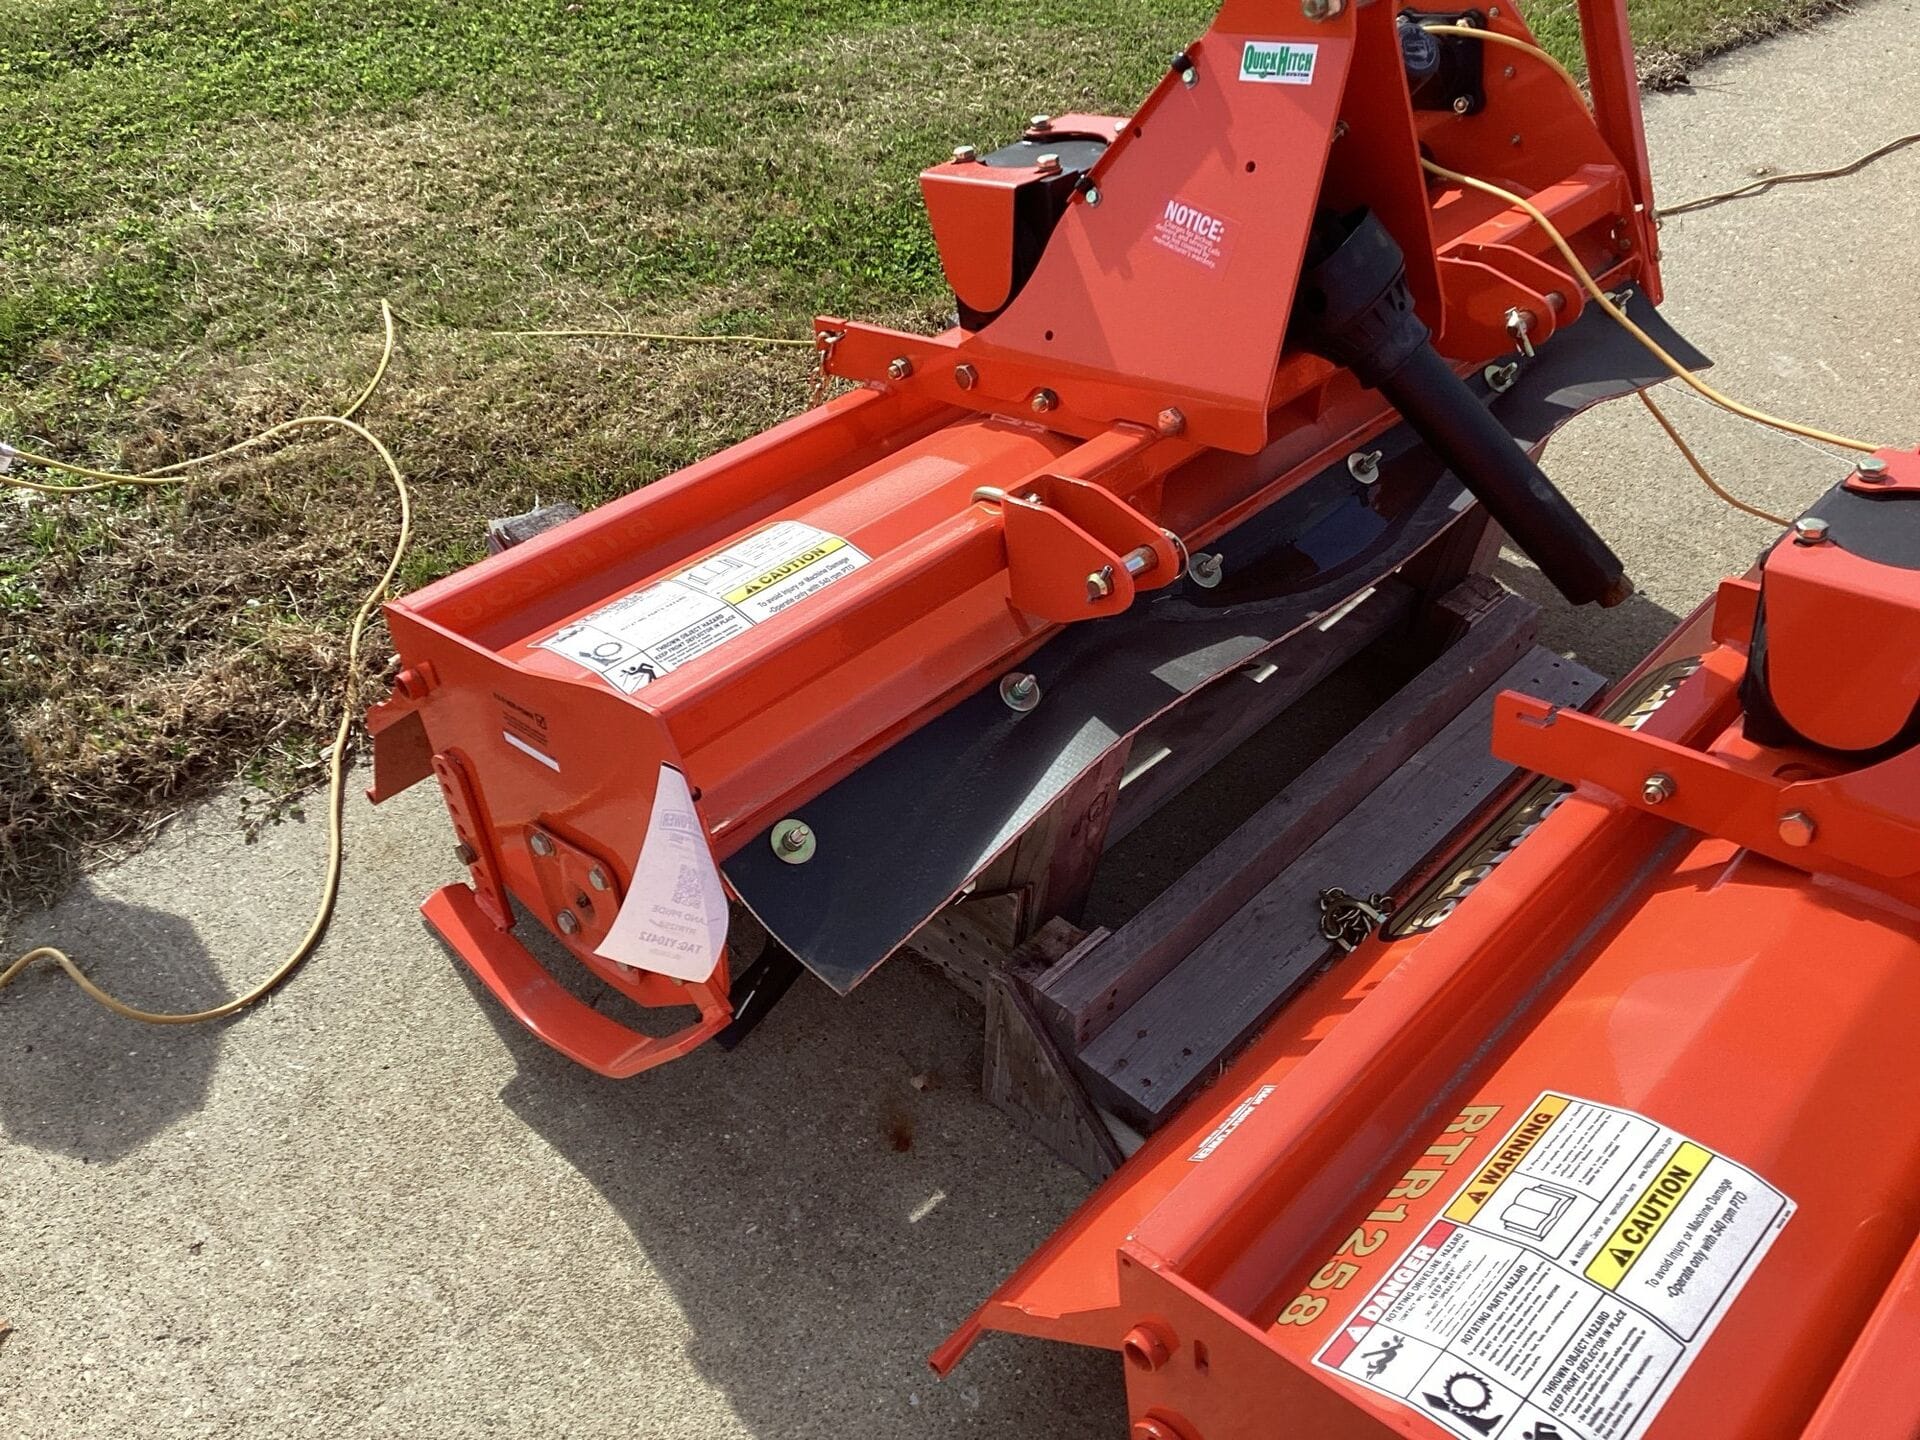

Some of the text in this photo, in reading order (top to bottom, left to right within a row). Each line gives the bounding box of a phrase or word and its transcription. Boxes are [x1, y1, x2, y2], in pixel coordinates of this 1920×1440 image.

[1164, 200, 1224, 242] NOTICE:
[759, 548, 826, 584] CAUTION
[654, 650, 668, 660] KEEP
[669, 641, 685, 653] FRONT
[685, 626, 714, 643] DEFLECTOR
[720, 614, 736, 625] PLACE
[656, 638, 680, 652] THROWN
[680, 625, 701, 639] OBJECT
[701, 614, 724, 627] HAZARD
[1478, 1112, 1553, 1185] WARNING
[1278, 1105, 1503, 1325] RTR1258
[1621, 1165, 1693, 1244] CAUTION
[1645, 1179, 1732, 1288] To avoid Injury or Machine Damage
[1690, 1250, 1708, 1268] only
[1701, 1234, 1717, 1252] with
[1710, 1220, 1727, 1237] 540
[1721, 1207, 1737, 1224] rpm
[1729, 1191, 1747, 1209] PTO
[1365, 1244, 1437, 1323] DANGER
[1385, 1292, 1415, 1322] ROTATING
[1412, 1260, 1442, 1291] DRIVELINE
[1441, 1233, 1463, 1257] HAZARD
[1428, 1284, 1442, 1299] KEEP
[1461, 1265, 1528, 1344] ROTATING PARTS HAZARD
[1542, 1311, 1609, 1396] THROWN OBJECT HAZARD
[1548, 1309, 1627, 1412] KEEP FRONT DEFLECTOR IN PLACE
